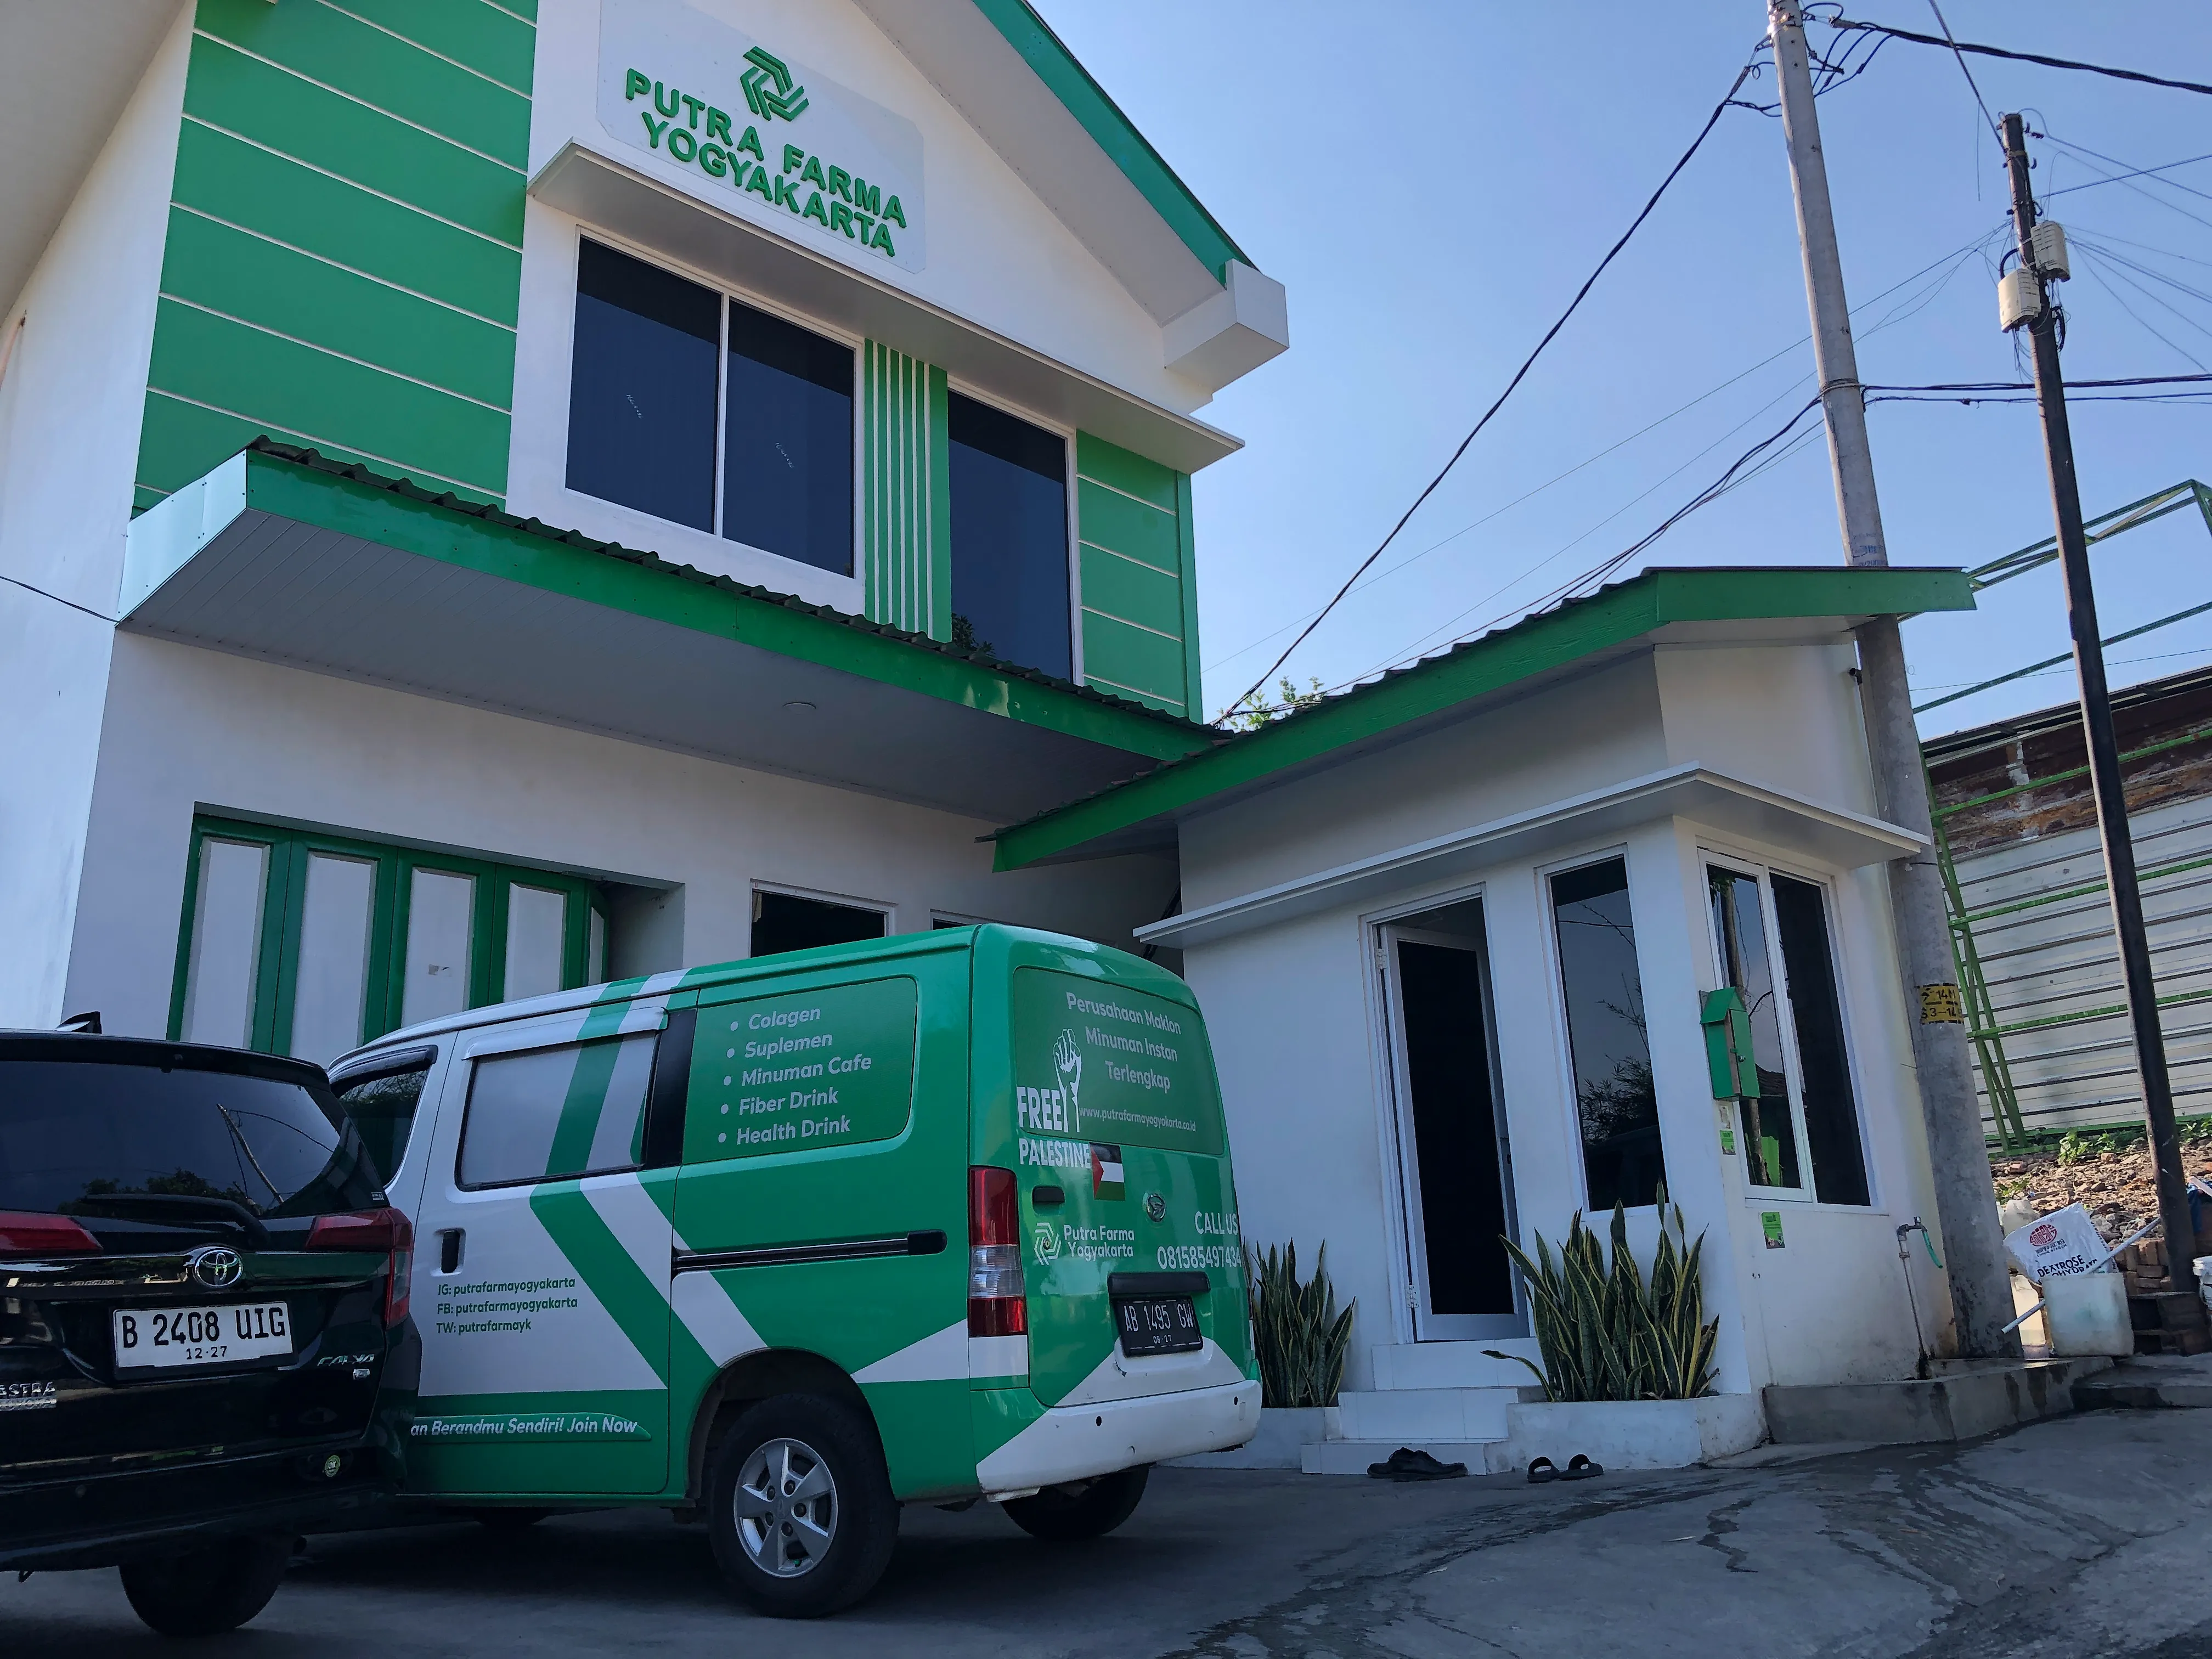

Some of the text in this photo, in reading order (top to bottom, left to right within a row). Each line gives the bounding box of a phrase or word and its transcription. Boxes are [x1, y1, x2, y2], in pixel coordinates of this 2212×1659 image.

[626, 68, 907, 228] PUTRA FARMA
[641, 111, 895, 257] YOGYAKARTA
[749, 1008, 820, 1030] Colagen
[1066, 992, 1181, 1035] Perusahaan Maklon
[744, 1034, 832, 1059] Suplemen
[1085, 1026, 1178, 1062] Minuman Instan
[742, 1053, 872, 1086] Minuman Cafe
[1105, 1060, 1170, 1093] Terlengkap
[739, 1087, 838, 1115] Fiber Drink
[1017, 1086, 1062, 1130] FREE
[737, 1115, 851, 1145] Health Drink
[1079, 1107, 1196, 1131] www.putrafarmayogyakarta.co.id
[1019, 1138, 1092, 1169] PALESTINE
[1064, 1224, 1135, 1241] Putra Farma
[1195, 1211, 1239, 1235] CALL US
[1067, 1242, 1133, 1261] Yogyakarta
[1157, 1245, 1242, 1269] 081585497434
[2037, 1255, 2085, 1277] DEXTROSE
[438, 1277, 575, 1297] IG: putrafarmayogyakarta
[437, 1296, 578, 1317] FB: putrafarmayogyakarta
[1124, 1304, 1194, 1331] AB 1495 GW
[122, 1306, 286, 1349] B 2408 UIG
[436, 1318, 532, 1335] TW: putrafarmayk
[432, 1419, 504, 1435] Berandmu
[507, 1416, 565, 1434] Sendiri!
[567, 1416, 598, 1433] Join
[602, 1417, 637, 1434] Now
